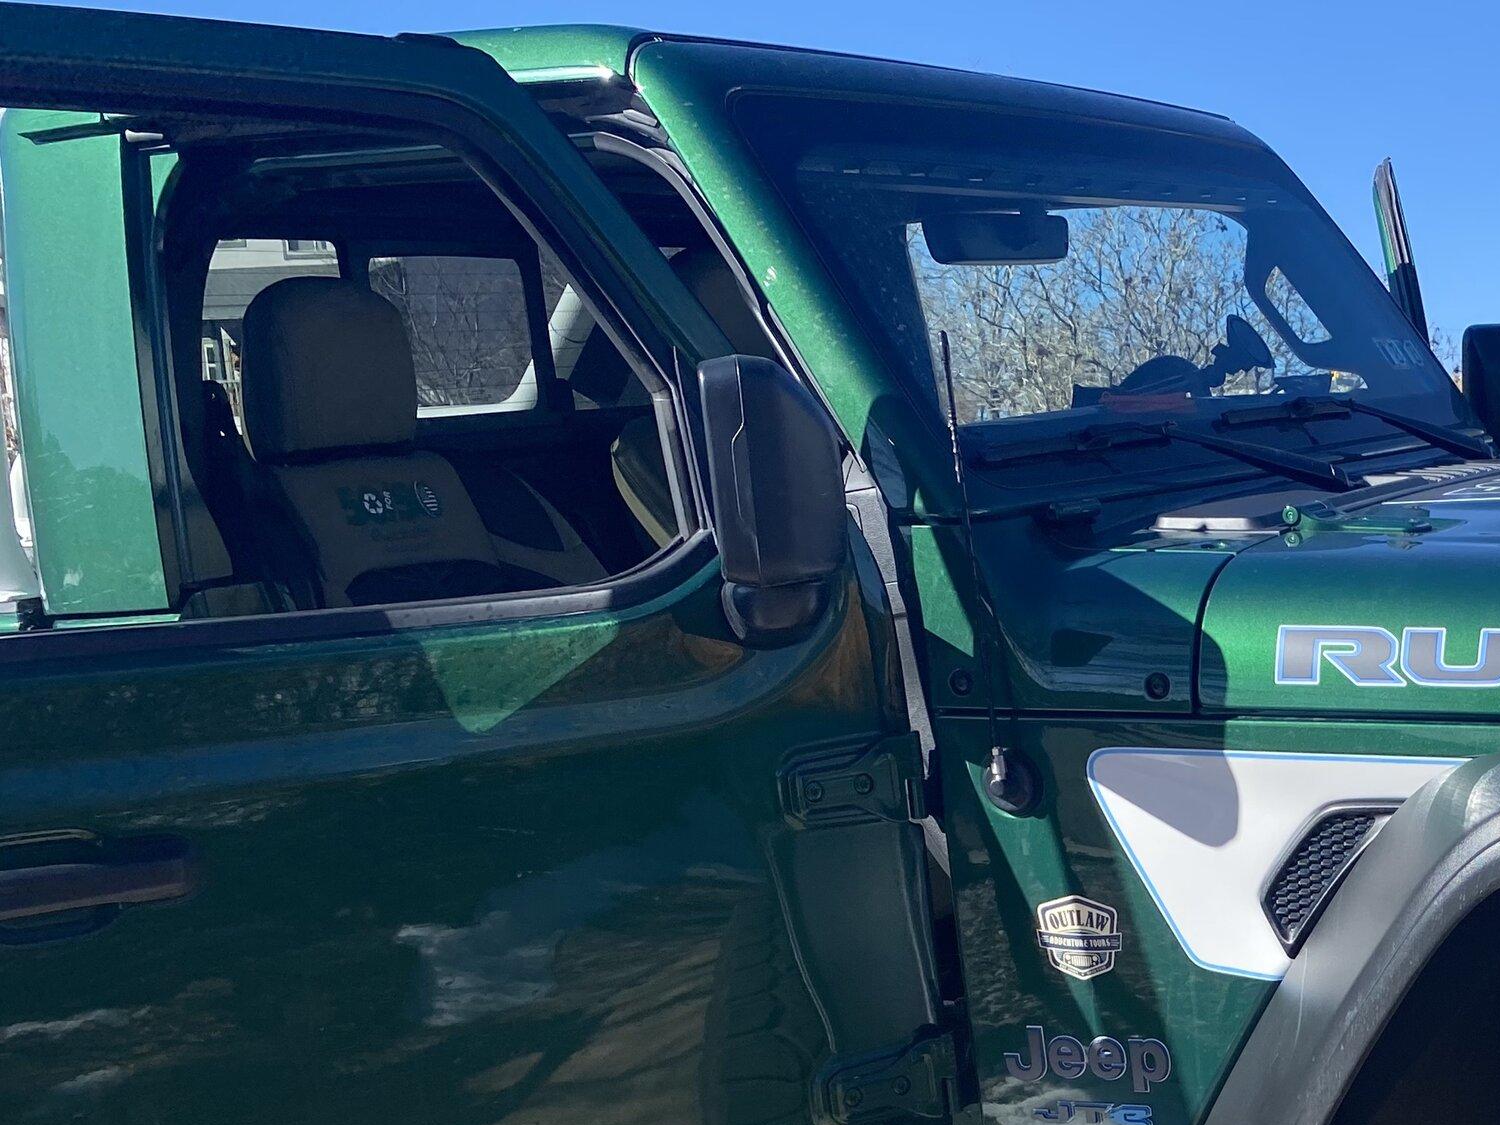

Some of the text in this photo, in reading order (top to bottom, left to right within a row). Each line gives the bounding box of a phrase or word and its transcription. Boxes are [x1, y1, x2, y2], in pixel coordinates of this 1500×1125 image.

[1049, 909, 1110, 932] OUTLAW
[1049, 936, 1111, 948] ADVENTURE TOURS
[1003, 1025, 1172, 1093] Jeep
